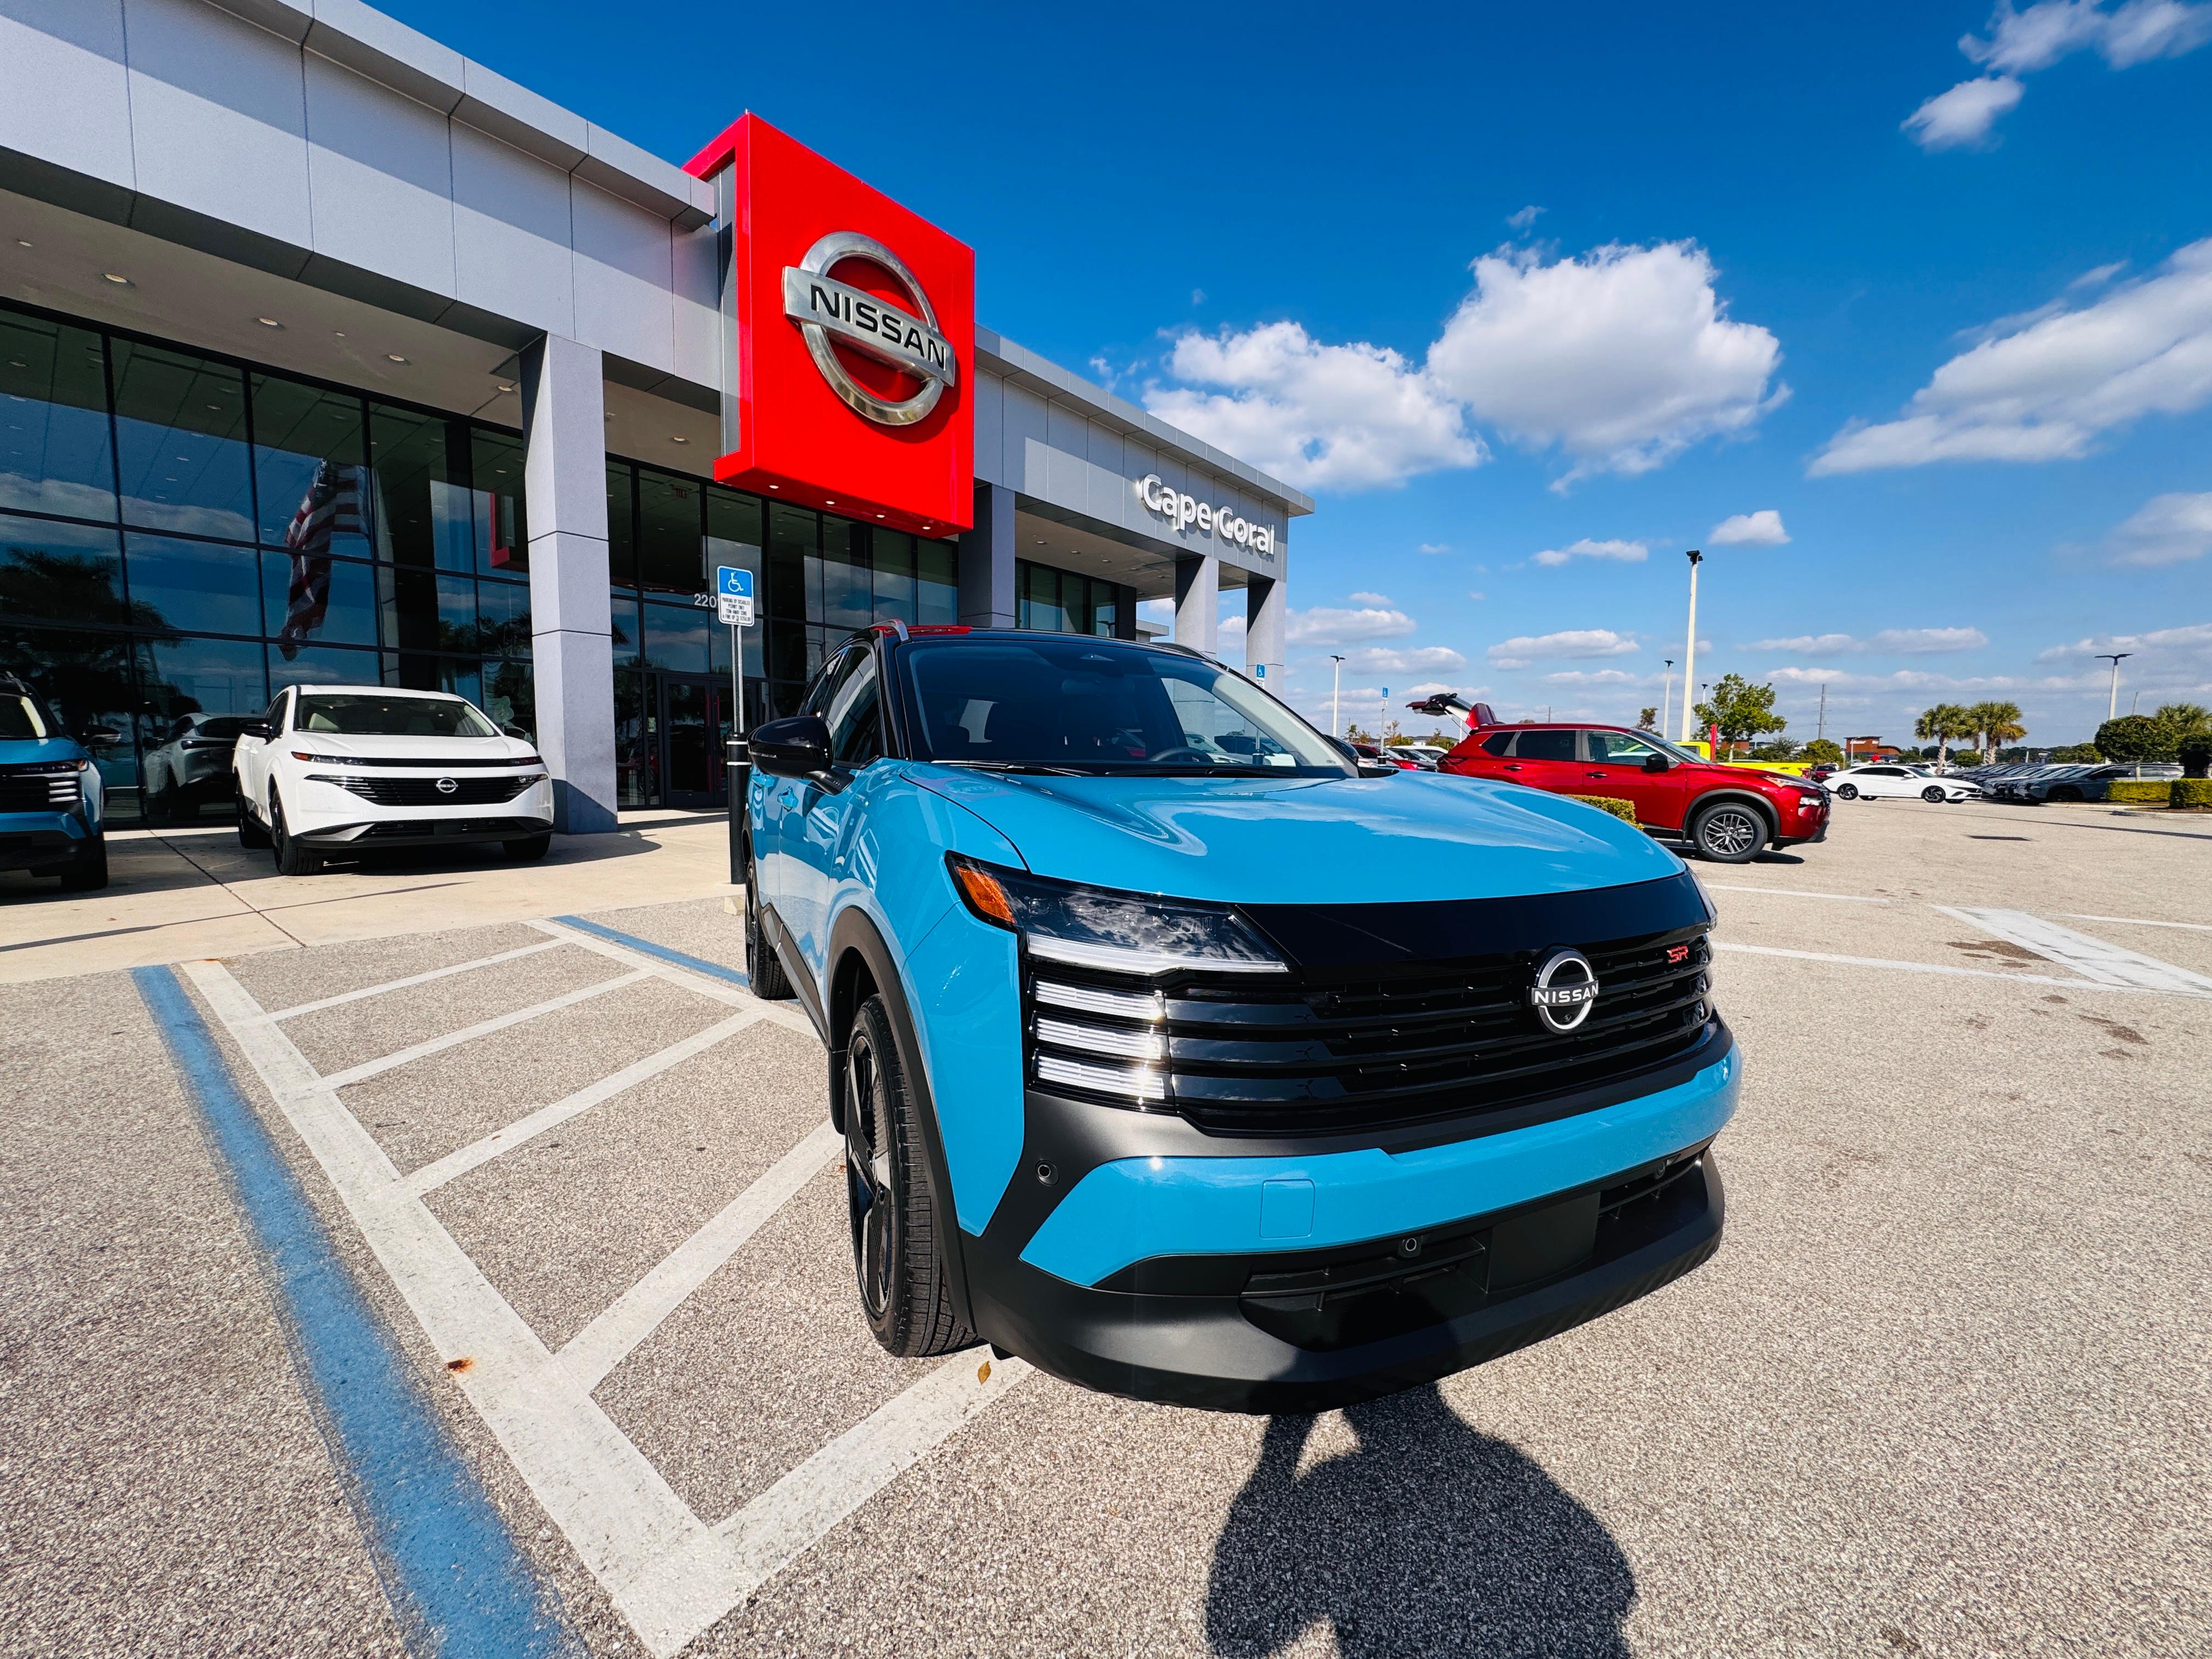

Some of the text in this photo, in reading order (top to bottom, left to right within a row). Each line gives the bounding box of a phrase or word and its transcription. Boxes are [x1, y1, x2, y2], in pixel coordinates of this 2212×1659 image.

[811, 284, 947, 371] NISSAN
[1142, 473, 1275, 555] Cape Coral
[694, 594, 718, 608] 220
[1667, 945, 1688, 963] SR
[1534, 984, 1599, 1004] NISSAN
